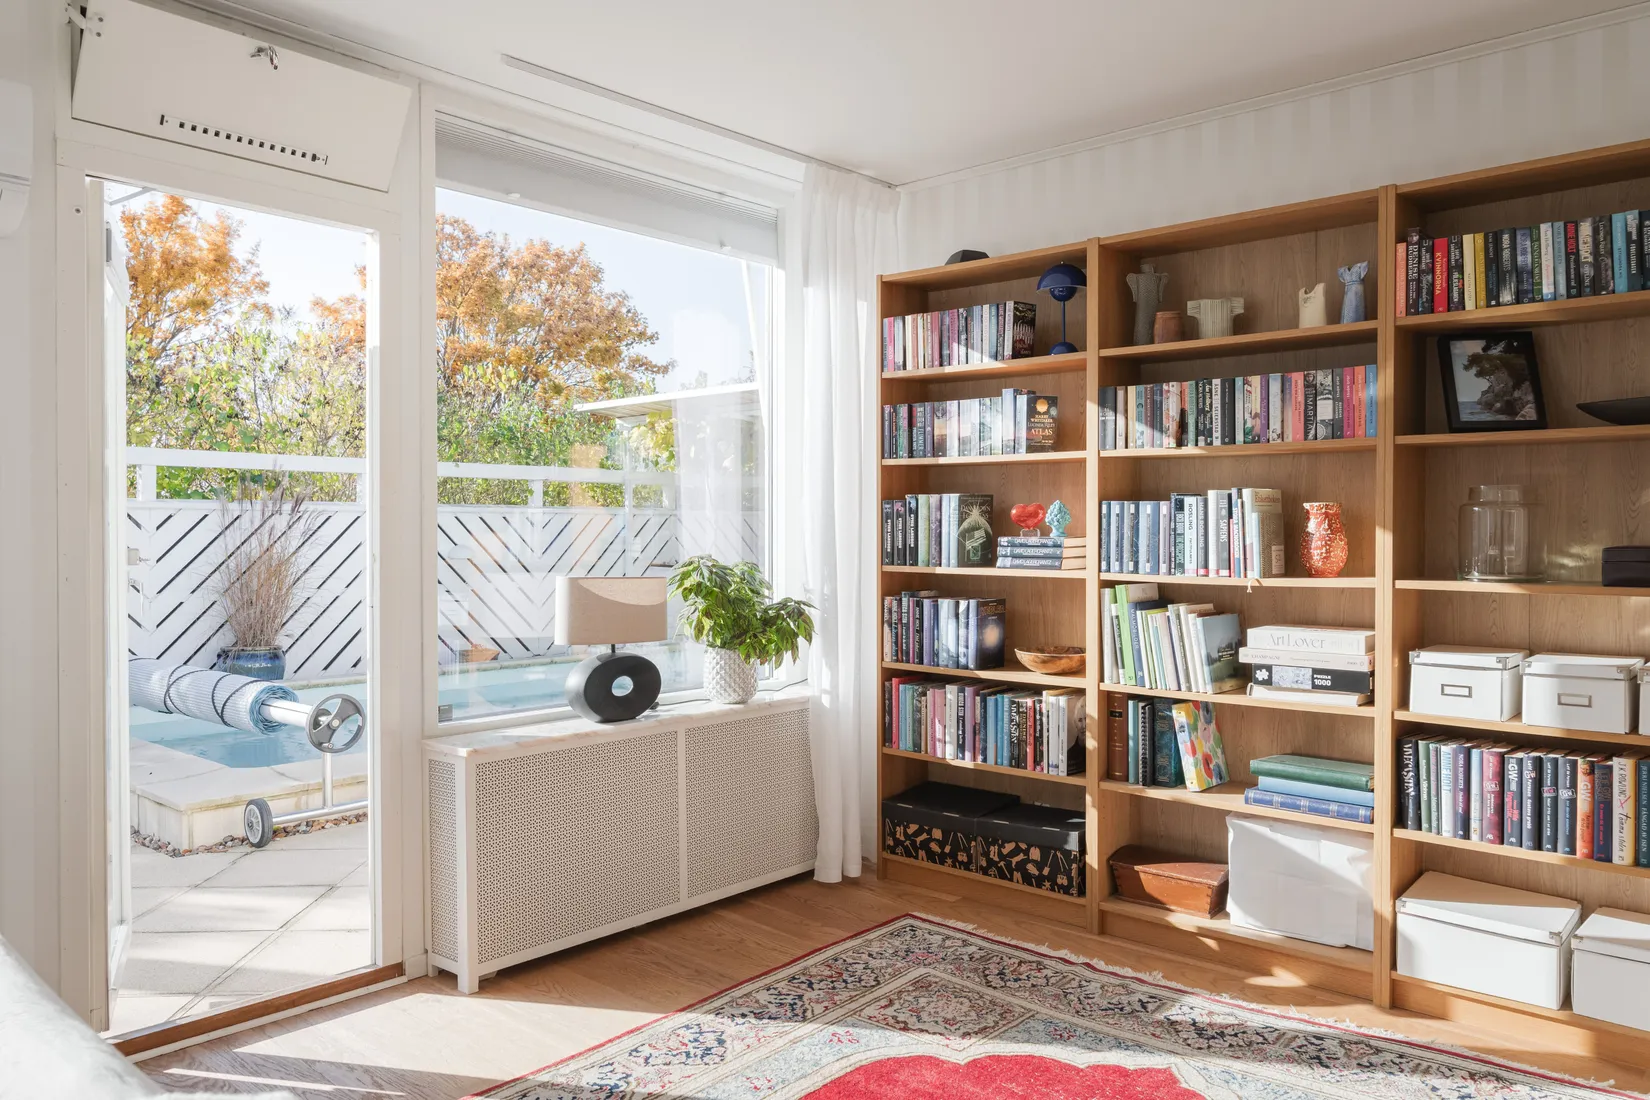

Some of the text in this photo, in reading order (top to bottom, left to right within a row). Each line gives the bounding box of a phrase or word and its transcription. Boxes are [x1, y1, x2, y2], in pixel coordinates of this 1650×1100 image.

[1502, 233, 1510, 249] NORA
[1567, 223, 1576, 239] ANNE
[1519, 232, 1529, 270] NORA ROBERTS
[1567, 238, 1576, 253] HOLT
[1580, 222, 1594, 286] ANNE HOLT OFFLINE
[1503, 248, 1511, 272] ROBERTS
[1030, 428, 1053, 436] ATLAS
[1219, 519, 1228, 543] SAPIENS
[1130, 608, 1140, 649] MALMÖBILDER
[1251, 653, 1281, 661] CHAMPAGNE
[1010, 724, 1018, 743] STEN
[1403, 743, 1413, 772] VIVECA
[1401, 771, 1416, 794] STEN
[1442, 750, 1452, 793] ANNE HOLT
[1508, 763, 1518, 782] GW
[1581, 781, 1591, 801] GW
[1618, 773, 1627, 799] ROWLING
[1618, 812, 1632, 852] tomma stolen
